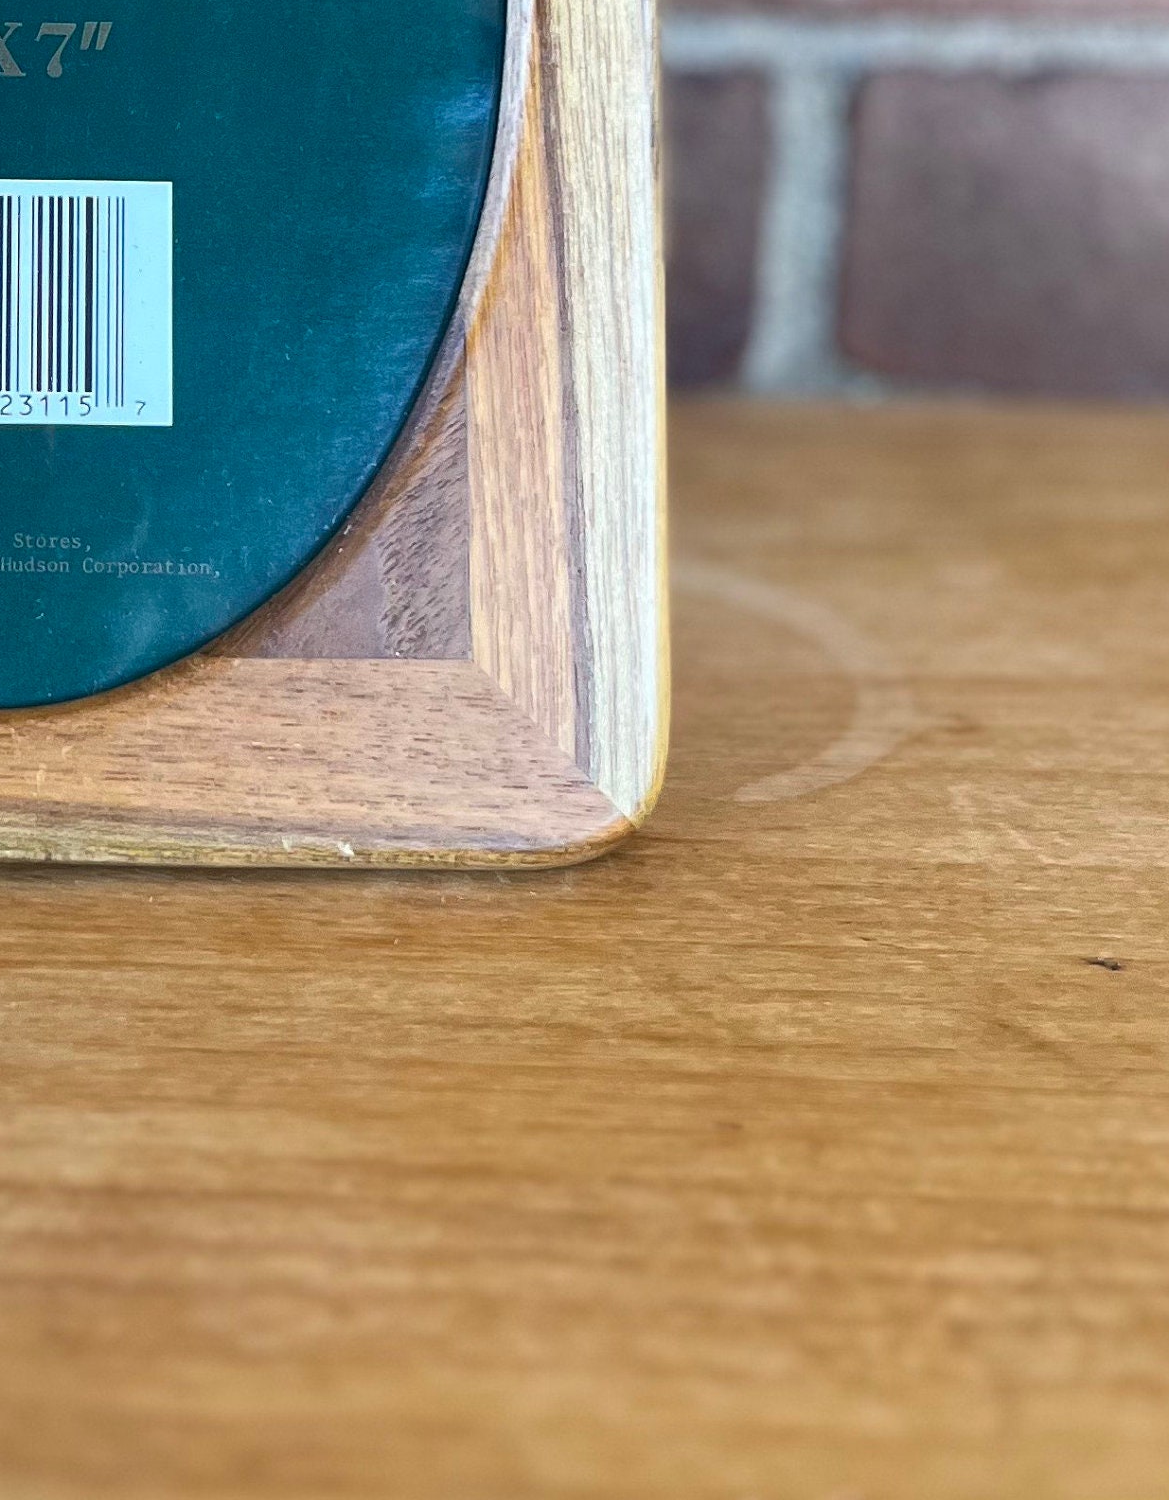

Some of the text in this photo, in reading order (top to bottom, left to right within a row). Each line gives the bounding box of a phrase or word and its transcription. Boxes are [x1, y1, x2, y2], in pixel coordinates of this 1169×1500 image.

[134, 399, 147, 417] 7
[13, 532, 91, 553] Stores,
[0, 556, 70, 573] Hudson
[82, 557, 220, 579] Corporation,
